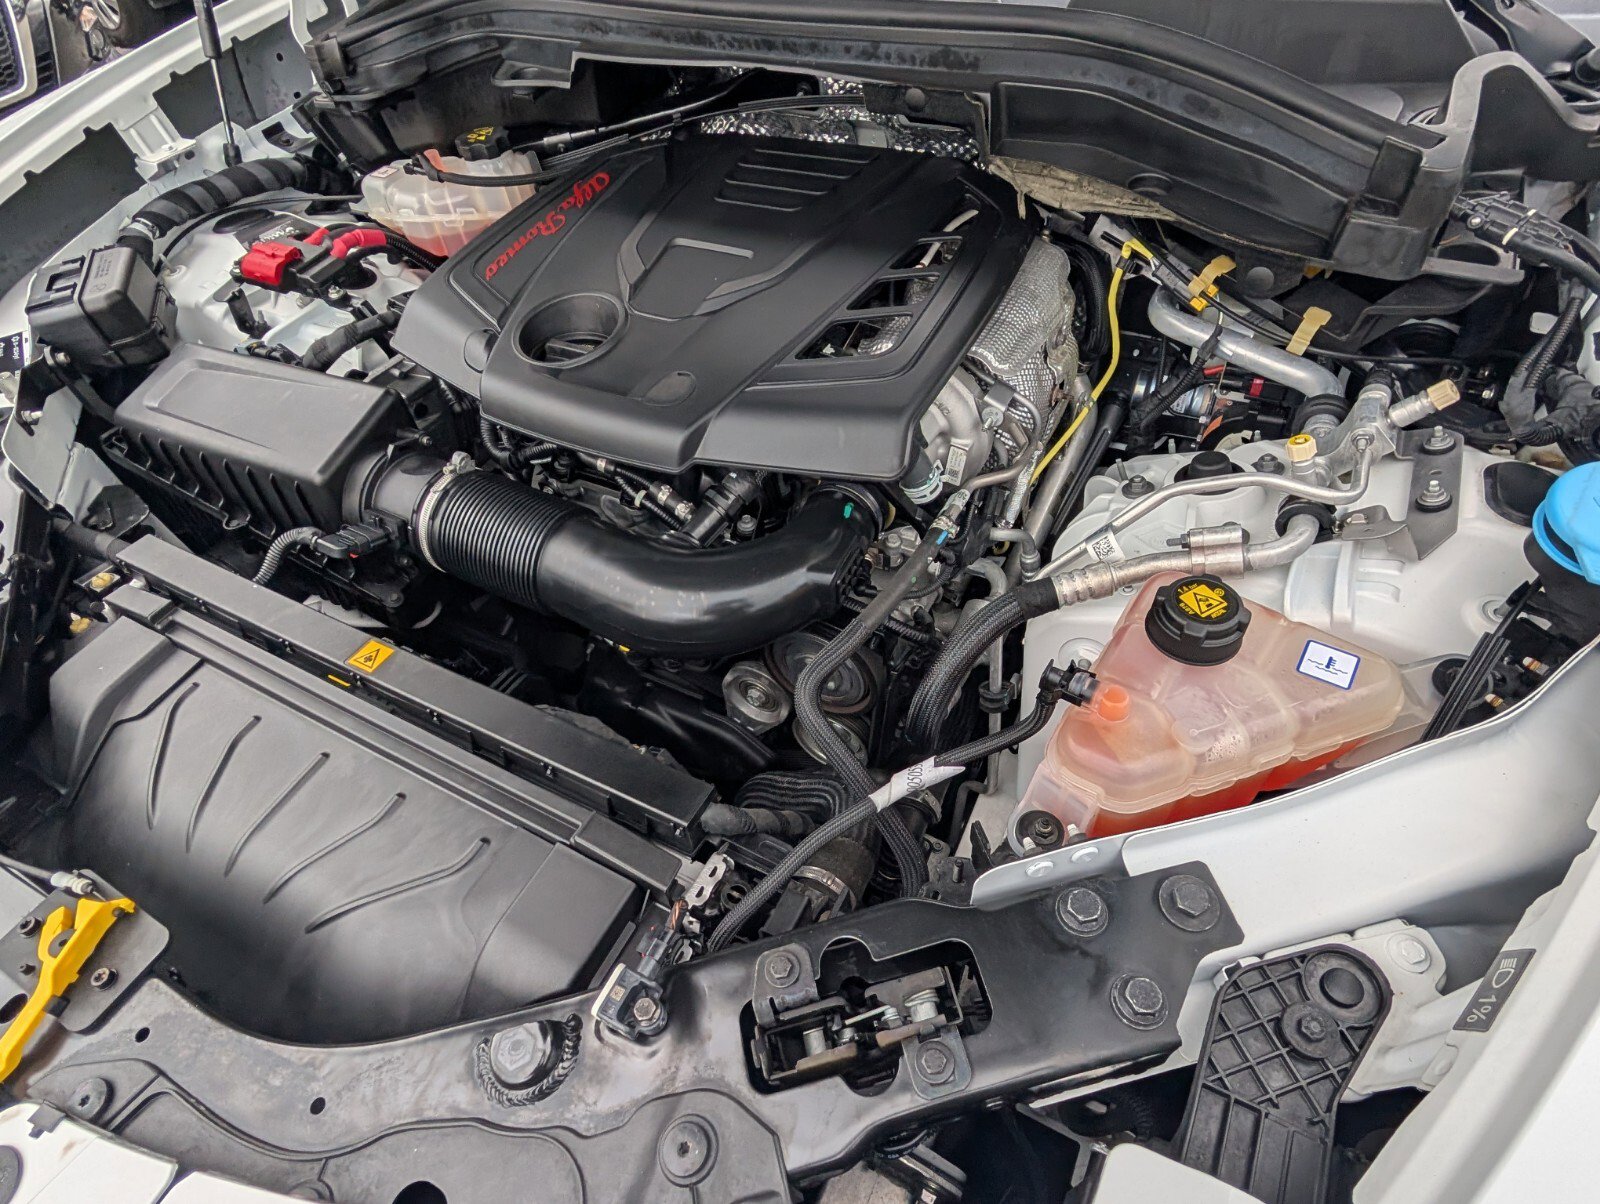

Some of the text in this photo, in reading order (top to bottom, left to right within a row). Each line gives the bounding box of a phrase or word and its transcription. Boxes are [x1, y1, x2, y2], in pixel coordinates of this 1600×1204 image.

[485, 172, 611, 281] Alfa Romeo
[1466, 994, 1497, 1023] 1%
